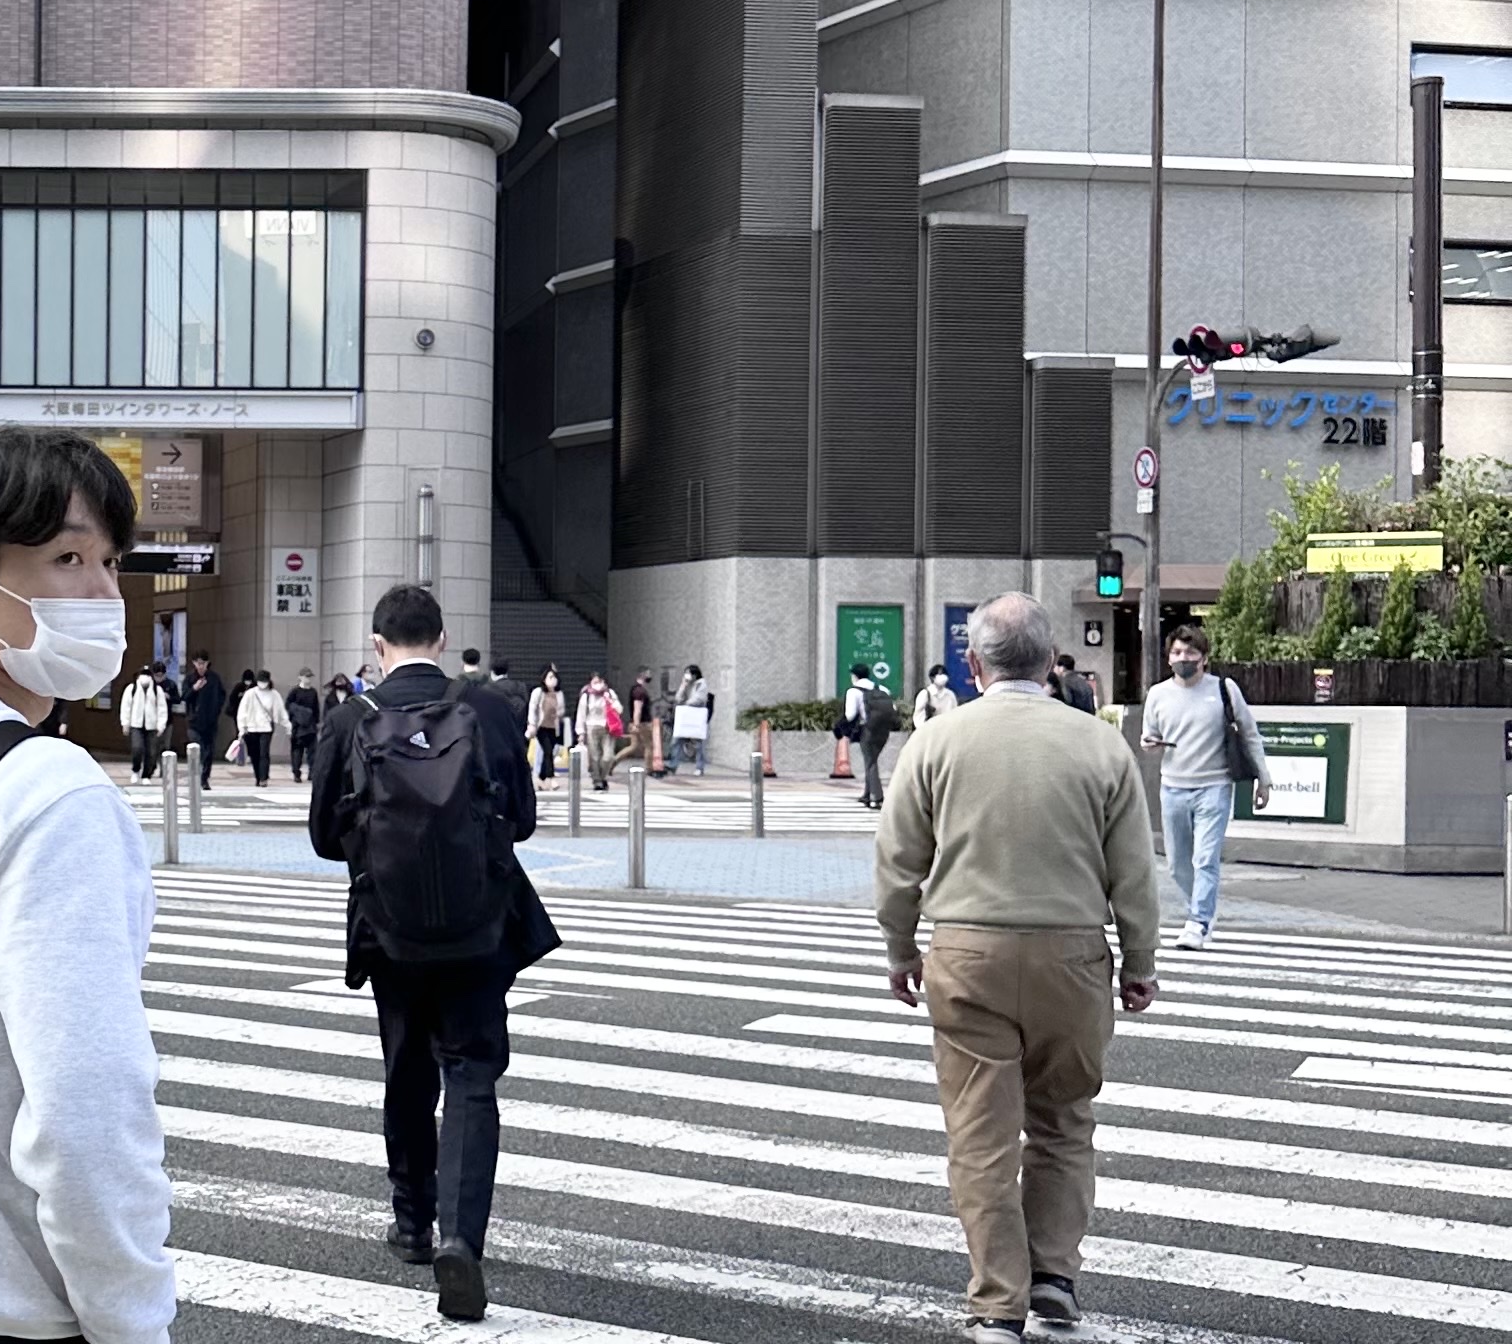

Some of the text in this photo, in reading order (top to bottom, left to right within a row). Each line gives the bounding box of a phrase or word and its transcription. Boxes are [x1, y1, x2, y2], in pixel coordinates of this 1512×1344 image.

[41, 402, 249, 417] 大阪梅田ツインタワーズ・ノース
[1322, 417, 1387, 446] 22階
[1268, 782, 1321, 794] ont-bell
